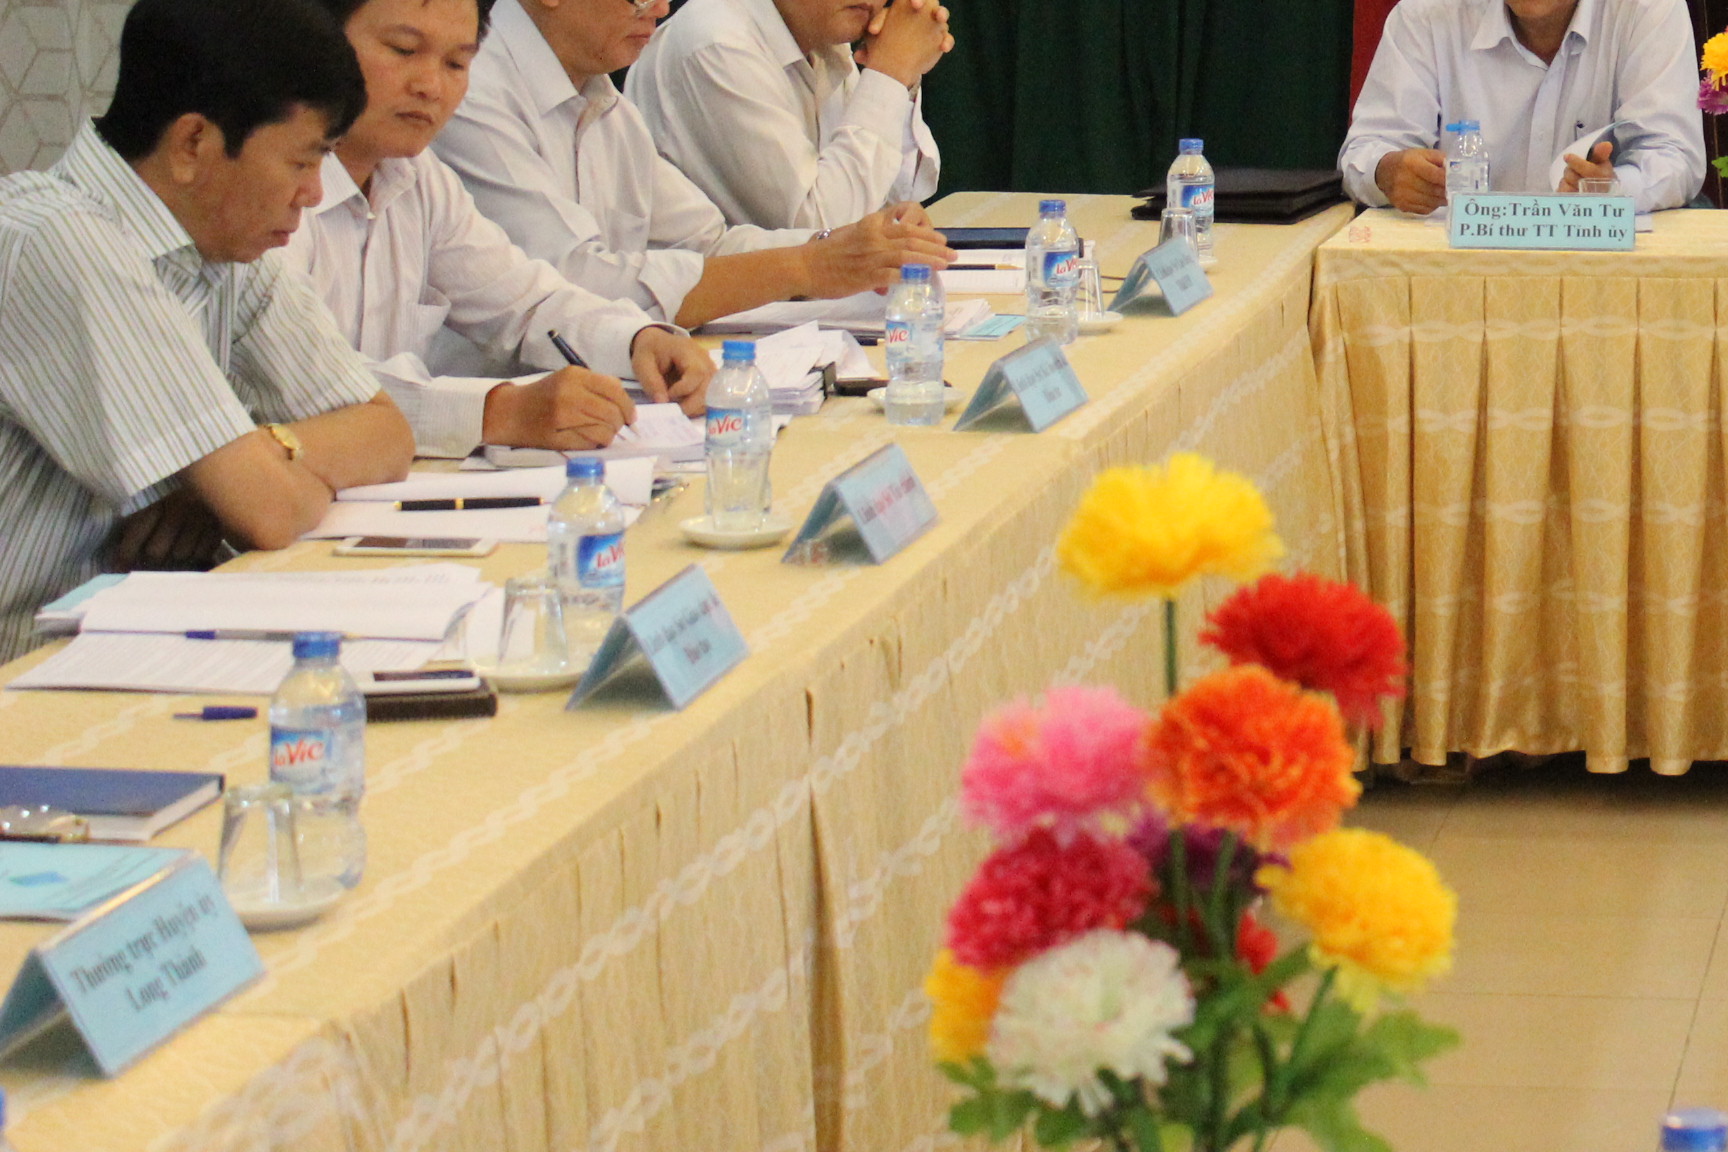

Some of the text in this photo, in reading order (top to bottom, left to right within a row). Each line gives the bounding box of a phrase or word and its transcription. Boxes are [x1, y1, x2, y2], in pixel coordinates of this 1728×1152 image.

[1558, 203, 1592, 217] Văn
[1599, 203, 1625, 218] Tư
[1459, 223, 1493, 237] P.Bí
[1499, 223, 1529, 237] thư
[1532, 223, 1558, 237] TT
